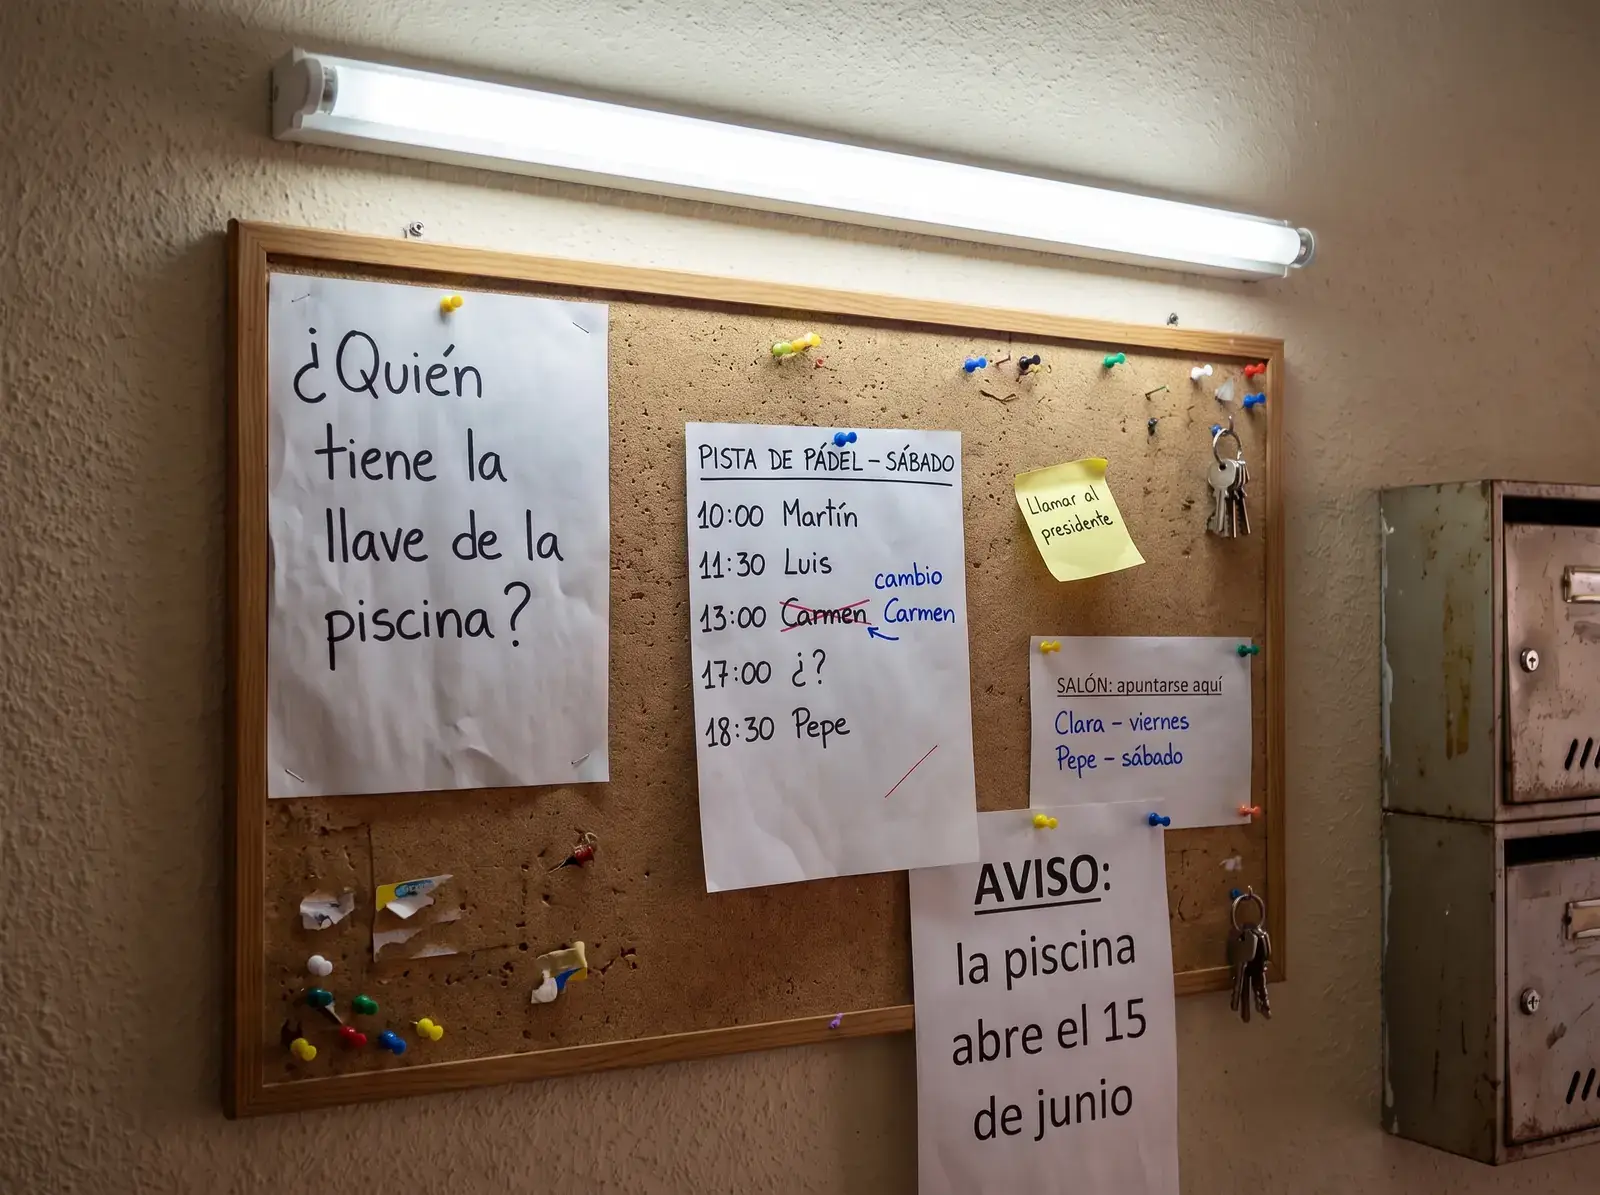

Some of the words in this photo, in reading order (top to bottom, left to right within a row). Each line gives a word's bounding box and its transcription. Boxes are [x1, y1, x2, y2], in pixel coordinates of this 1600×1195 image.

[293, 327, 483, 403] ¿Quién
[314, 423, 437, 481] tiene
[467, 428, 507, 482] la
[698, 444, 757, 470] PISTA
[768, 449, 793, 470] DE
[804, 442, 864, 471] PÁDEL
[885, 444, 955, 472] SÁBADO
[698, 500, 765, 529] 10:00
[782, 498, 858, 528] Martín
[1026, 495, 1077, 516] Llamar
[1085, 485, 1100, 502] al
[326, 507, 429, 563] llave
[452, 509, 502, 560] de
[526, 509, 564, 561] la
[1041, 512, 1114, 545] presidente
[699, 550, 766, 580] 11:30
[784, 548, 833, 575] Luis
[874, 562, 943, 590] cambio
[325, 581, 531, 671] piscina?
[700, 603, 767, 633] 13:00
[884, 597, 956, 624] Carmen
[701, 659, 772, 689] 17:00
[1056, 673, 1113, 694] SALÓN:
[1117, 679, 1189, 699] apuntarse
[1192, 676, 1223, 698] aquí
[705, 716, 775, 747] 18:30
[791, 707, 851, 749] Pepe
[1055, 711, 1105, 735] Clara
[1129, 711, 1190, 731] viernes
[1055, 745, 1098, 779] Pepe
[1121, 742, 1183, 768] sábado
[974, 854, 1111, 906] AVISO:
[957, 942, 989, 985] la
[1005, 929, 1136, 990] piscina
[952, 1019, 1043, 1066] abre
[1057, 1003, 1089, 1049] el
[1103, 998, 1147, 1042] 15
[973, 1095, 1023, 1141] de
[1034, 1078, 1133, 1142] junio
